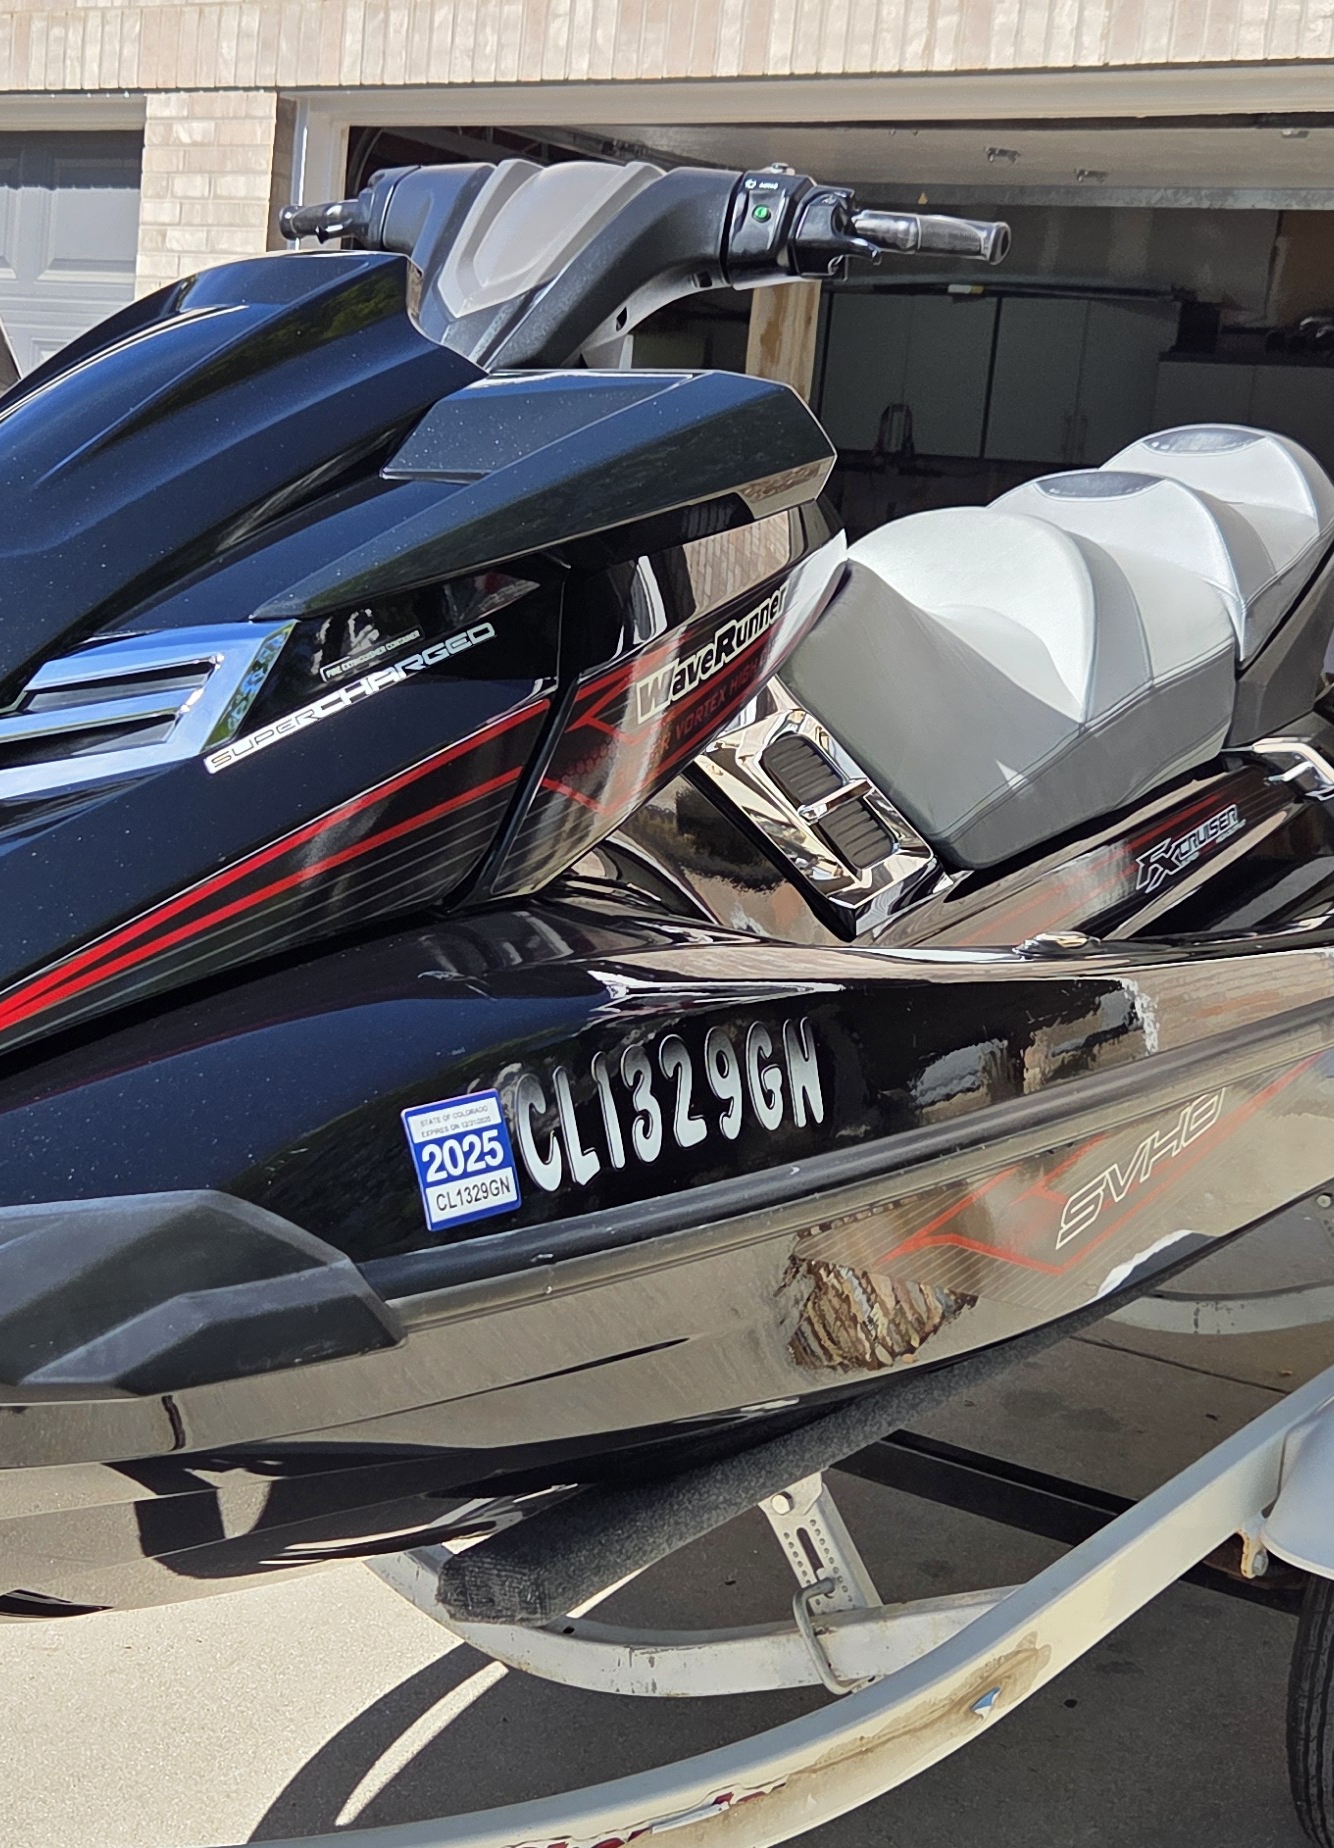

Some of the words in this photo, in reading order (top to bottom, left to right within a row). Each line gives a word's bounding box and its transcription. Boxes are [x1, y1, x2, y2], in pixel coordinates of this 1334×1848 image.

[207, 621, 496, 770] SUPERCHARGED
[635, 578, 789, 725] WaveRunner
[675, 686, 727, 740] VORTEX
[1135, 837, 1181, 894] FX
[1174, 804, 1238, 860] CRUISER
[420, 1116, 442, 1128] STATE
[442, 1113, 451, 1123] OF
[452, 1104, 488, 1120] COLORADO
[515, 1015, 824, 1192] CL1329GN
[421, 1129, 504, 1183] 2025
[436, 1175, 511, 1212] CL1329GN
[1056, 1087, 1226, 1250] SVHO
